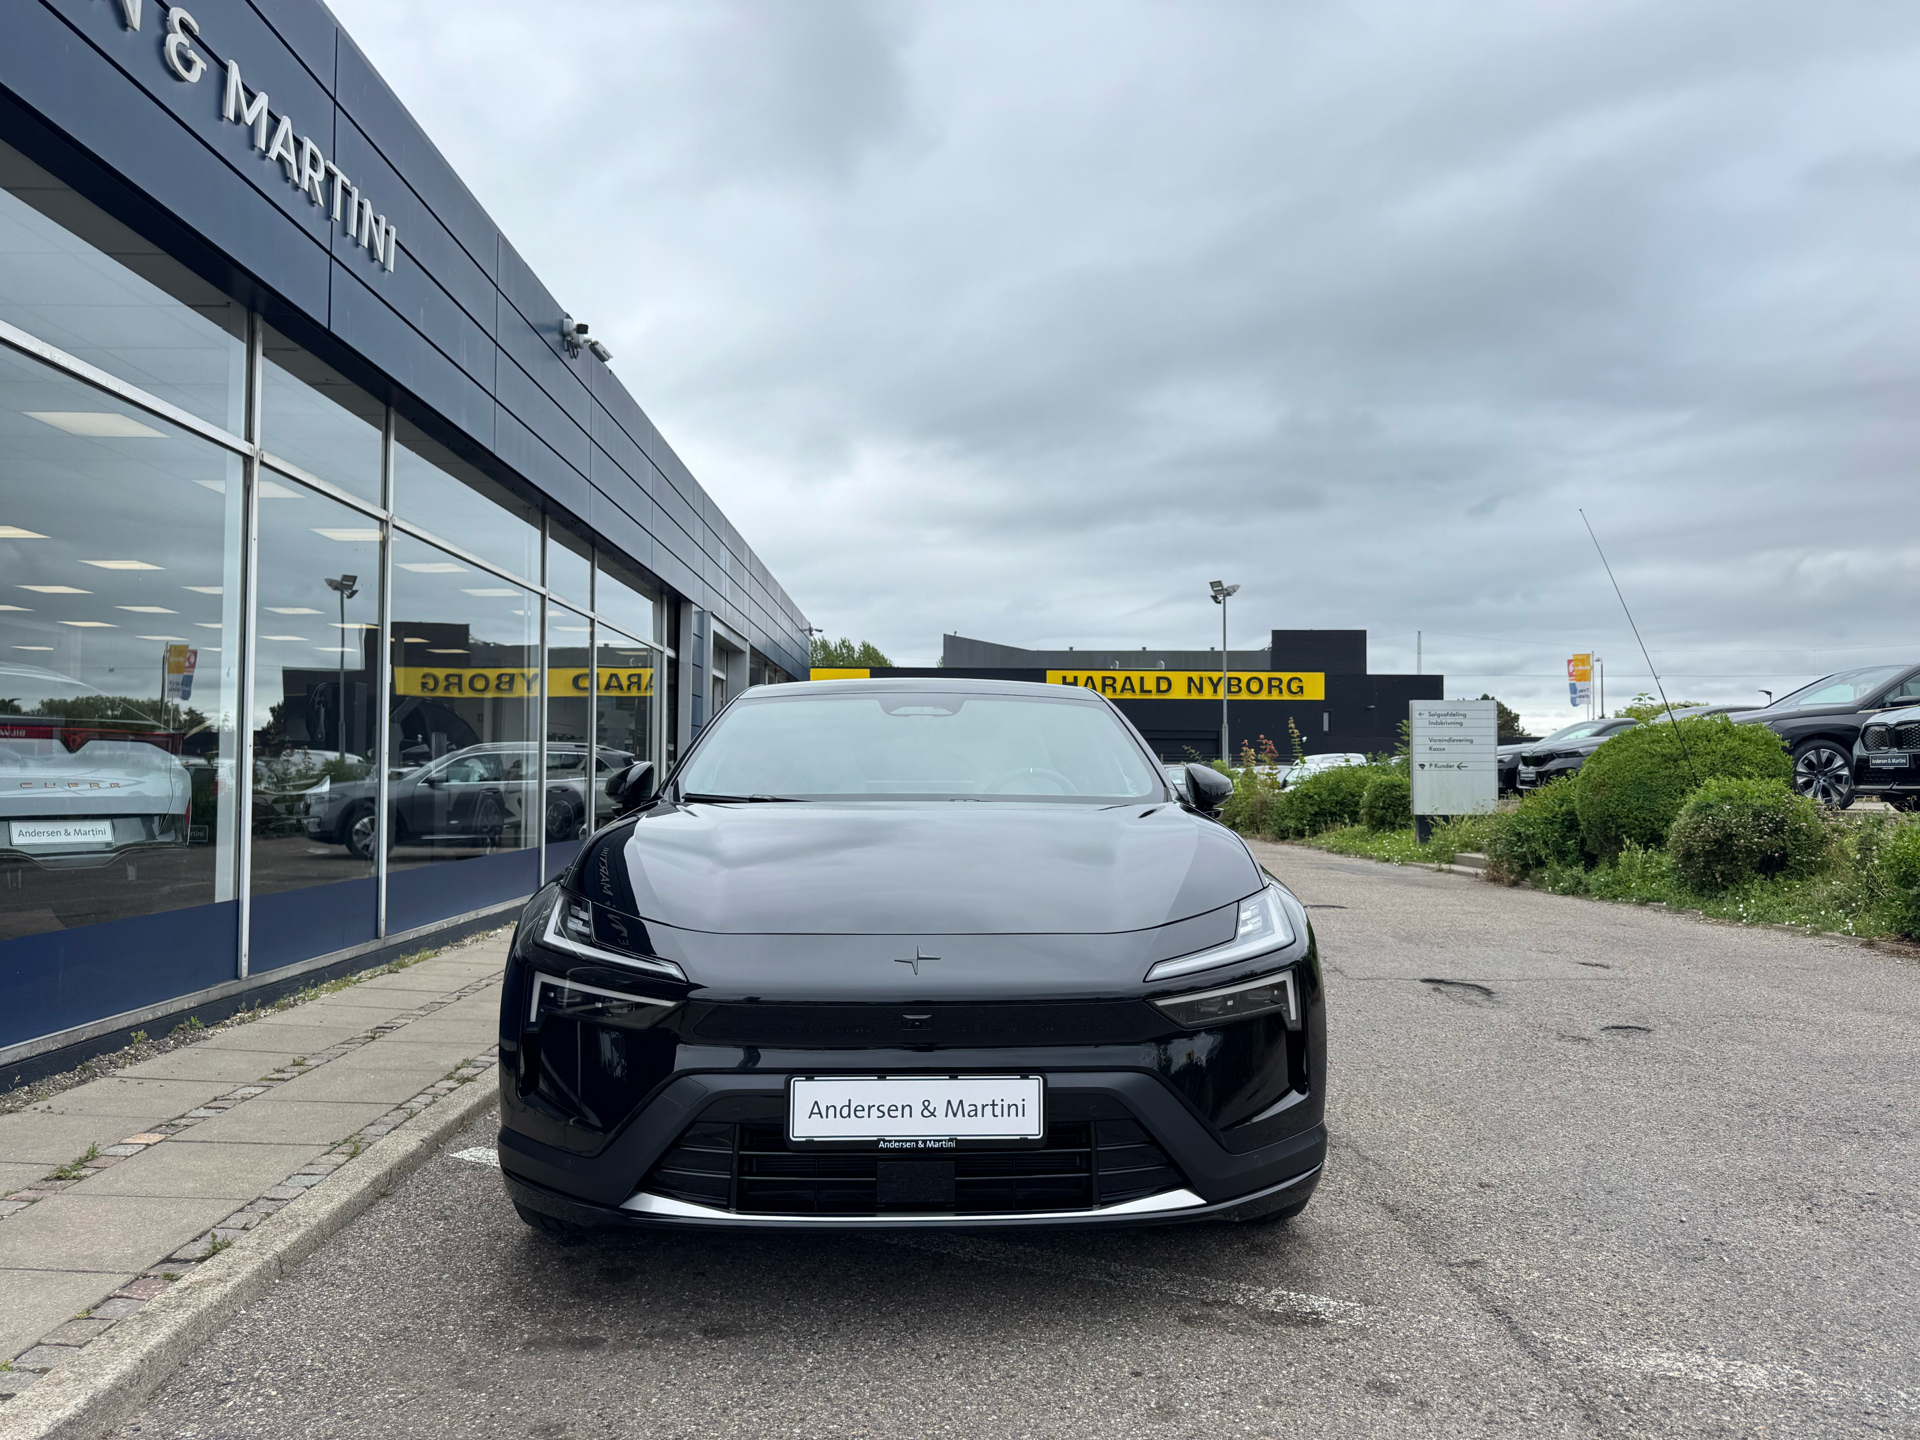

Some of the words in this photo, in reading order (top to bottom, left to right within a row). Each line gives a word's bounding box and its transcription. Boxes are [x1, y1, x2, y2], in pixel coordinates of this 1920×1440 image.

[164, 7, 207, 83] &
[222, 59, 396, 273] MARTINI
[1062, 675, 1173, 694] HARALD
[1187, 676, 1305, 695] NYBORG
[18, 828, 62, 838] Andersen
[73, 828, 107, 837] Martini
[808, 1098, 913, 1119] Andersen
[920, 1099, 937, 1118] &
[944, 1098, 1026, 1118] Martini
[878, 1140, 916, 1148] Andersen
[917, 1140, 924, 1148] &
[926, 1140, 956, 1148] Martini
